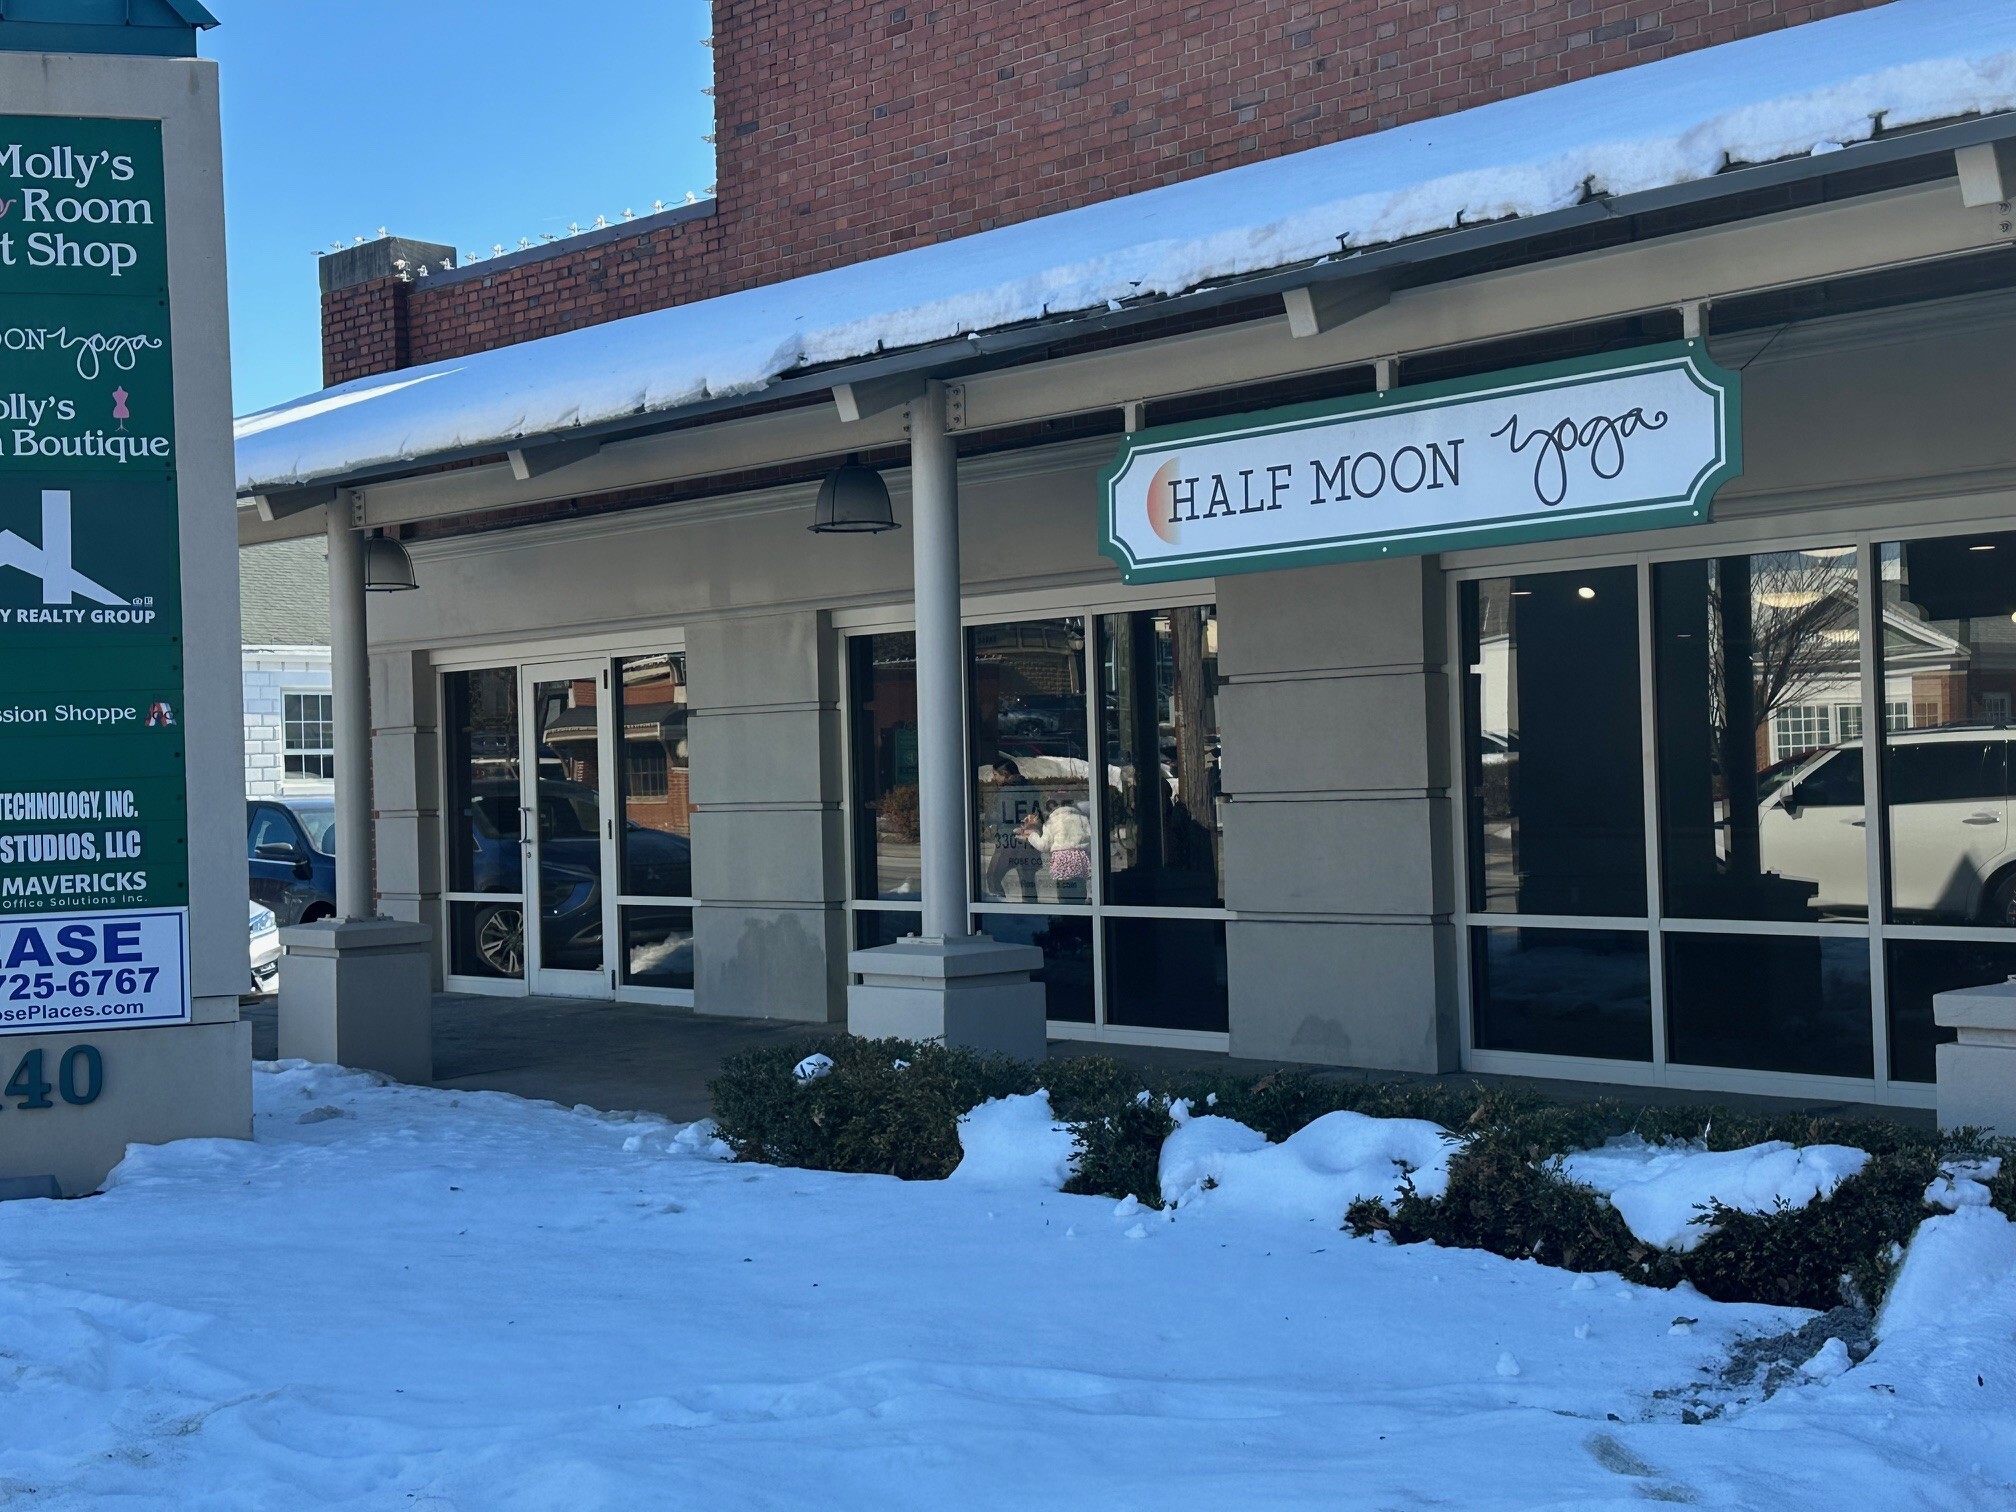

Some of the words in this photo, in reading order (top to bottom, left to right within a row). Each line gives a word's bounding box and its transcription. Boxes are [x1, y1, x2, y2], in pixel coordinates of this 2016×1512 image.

[0, 144, 135, 189] Molly's
[20, 188, 154, 225] Room
[27, 231, 138, 277] Shop
[0, 327, 47, 350] ON
[12, 429, 170, 464] Boutique
[1167, 464, 1293, 523] HALF
[1309, 438, 1465, 504] MOON
[17, 609, 86, 623] REALTY
[90, 609, 156, 624] GROUP
[0, 706, 48, 723] sion
[54, 704, 137, 725] Shoppe
[105, 789, 139, 818] INC.
[1001, 799, 1075, 824] LEA
[0, 832, 101, 864] STUDIOS,
[105, 829, 141, 859] LLC
[2, 871, 147, 897] MAVERICKS
[2, 898, 44, 909] Office
[50, 895, 116, 907] Solutions
[122, 894, 148, 903] Inc.
[0, 922, 143, 969] ASE
[0, 1002, 144, 1021] sePlaces.com
[0, 1044, 104, 1110] 40
